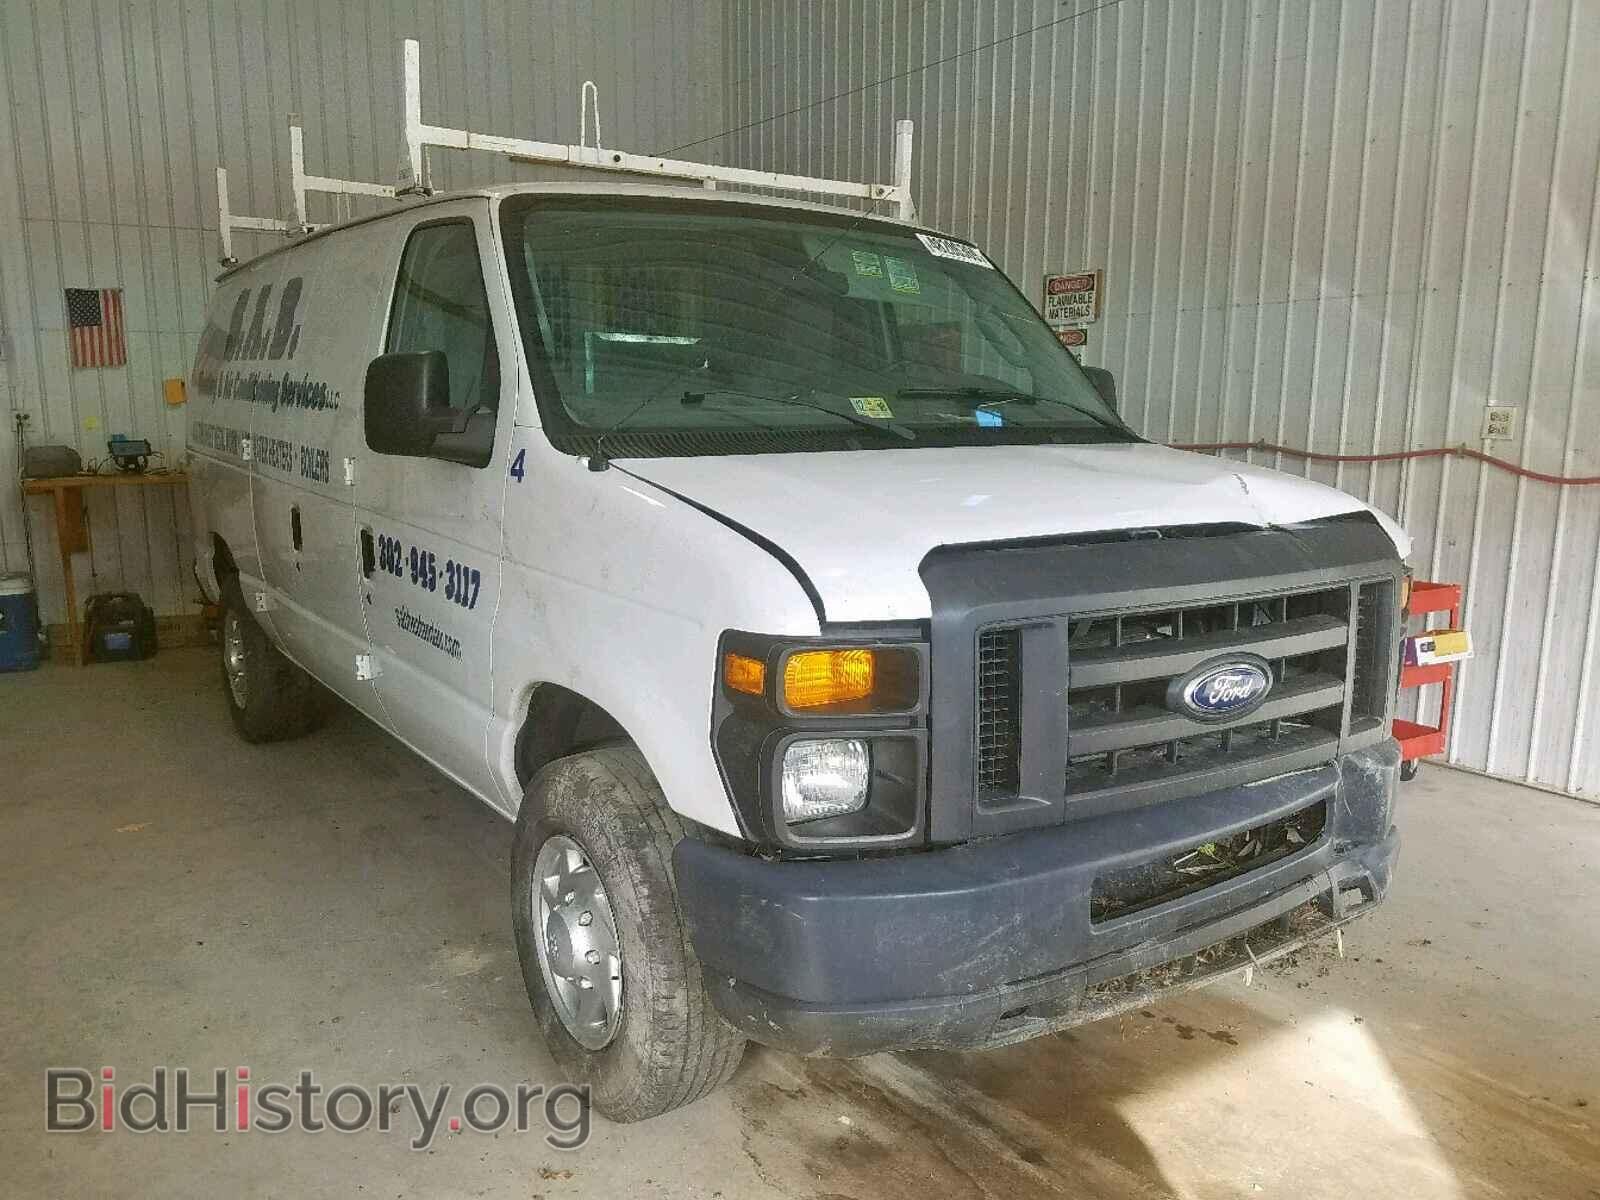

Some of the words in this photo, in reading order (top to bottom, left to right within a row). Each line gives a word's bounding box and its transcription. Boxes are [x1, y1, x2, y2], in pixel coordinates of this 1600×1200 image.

[1054, 279, 1088, 292] DANGER
[1048, 292, 1093, 307] FLAMMABLE
[1048, 305, 1091, 320] MATERIALS
[281, 371, 327, 411] Services
[510, 448, 526, 483] 4
[1208, 675, 1254, 705] Ford
